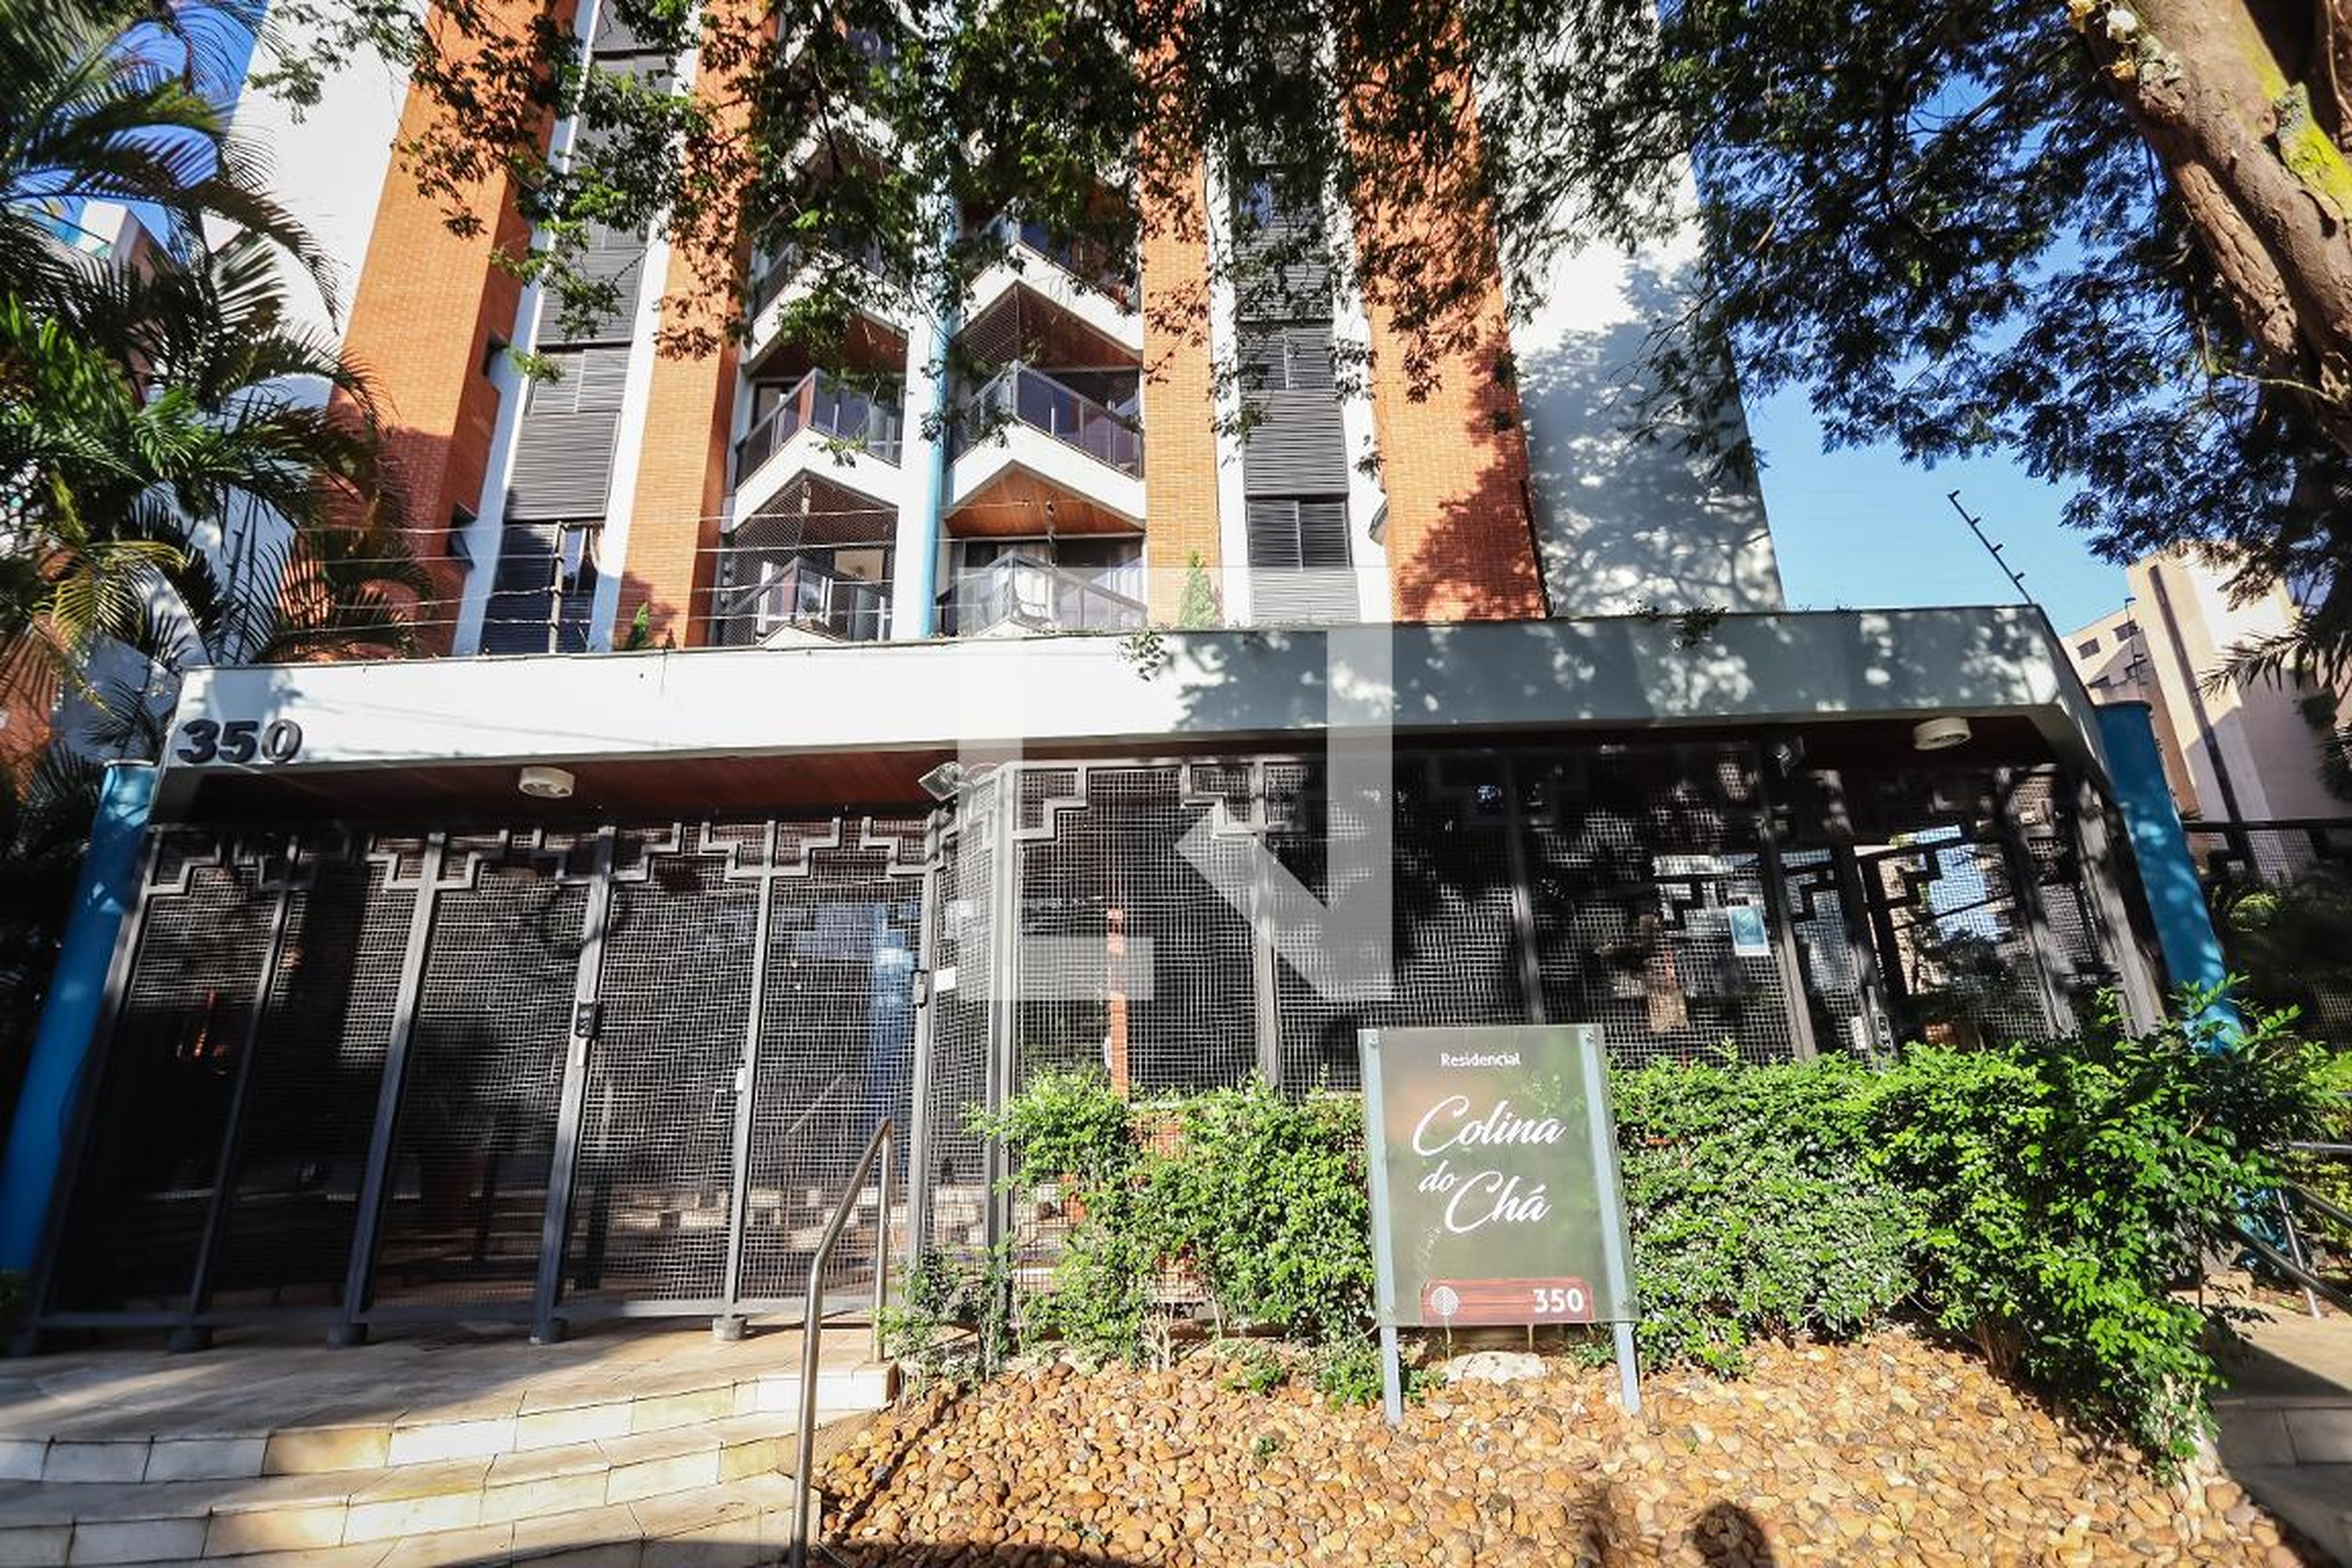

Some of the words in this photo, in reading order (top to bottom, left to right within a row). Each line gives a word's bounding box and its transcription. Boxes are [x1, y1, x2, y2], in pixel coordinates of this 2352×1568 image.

[177, 718, 303, 764] 350
[1441, 1053, 1520, 1067] Residencial
[1412, 1095, 1567, 1156] Colina
[1418, 1161, 1459, 1193] do
[1446, 1171, 1553, 1233] Chá
[1533, 1288, 1584, 1313] 350
